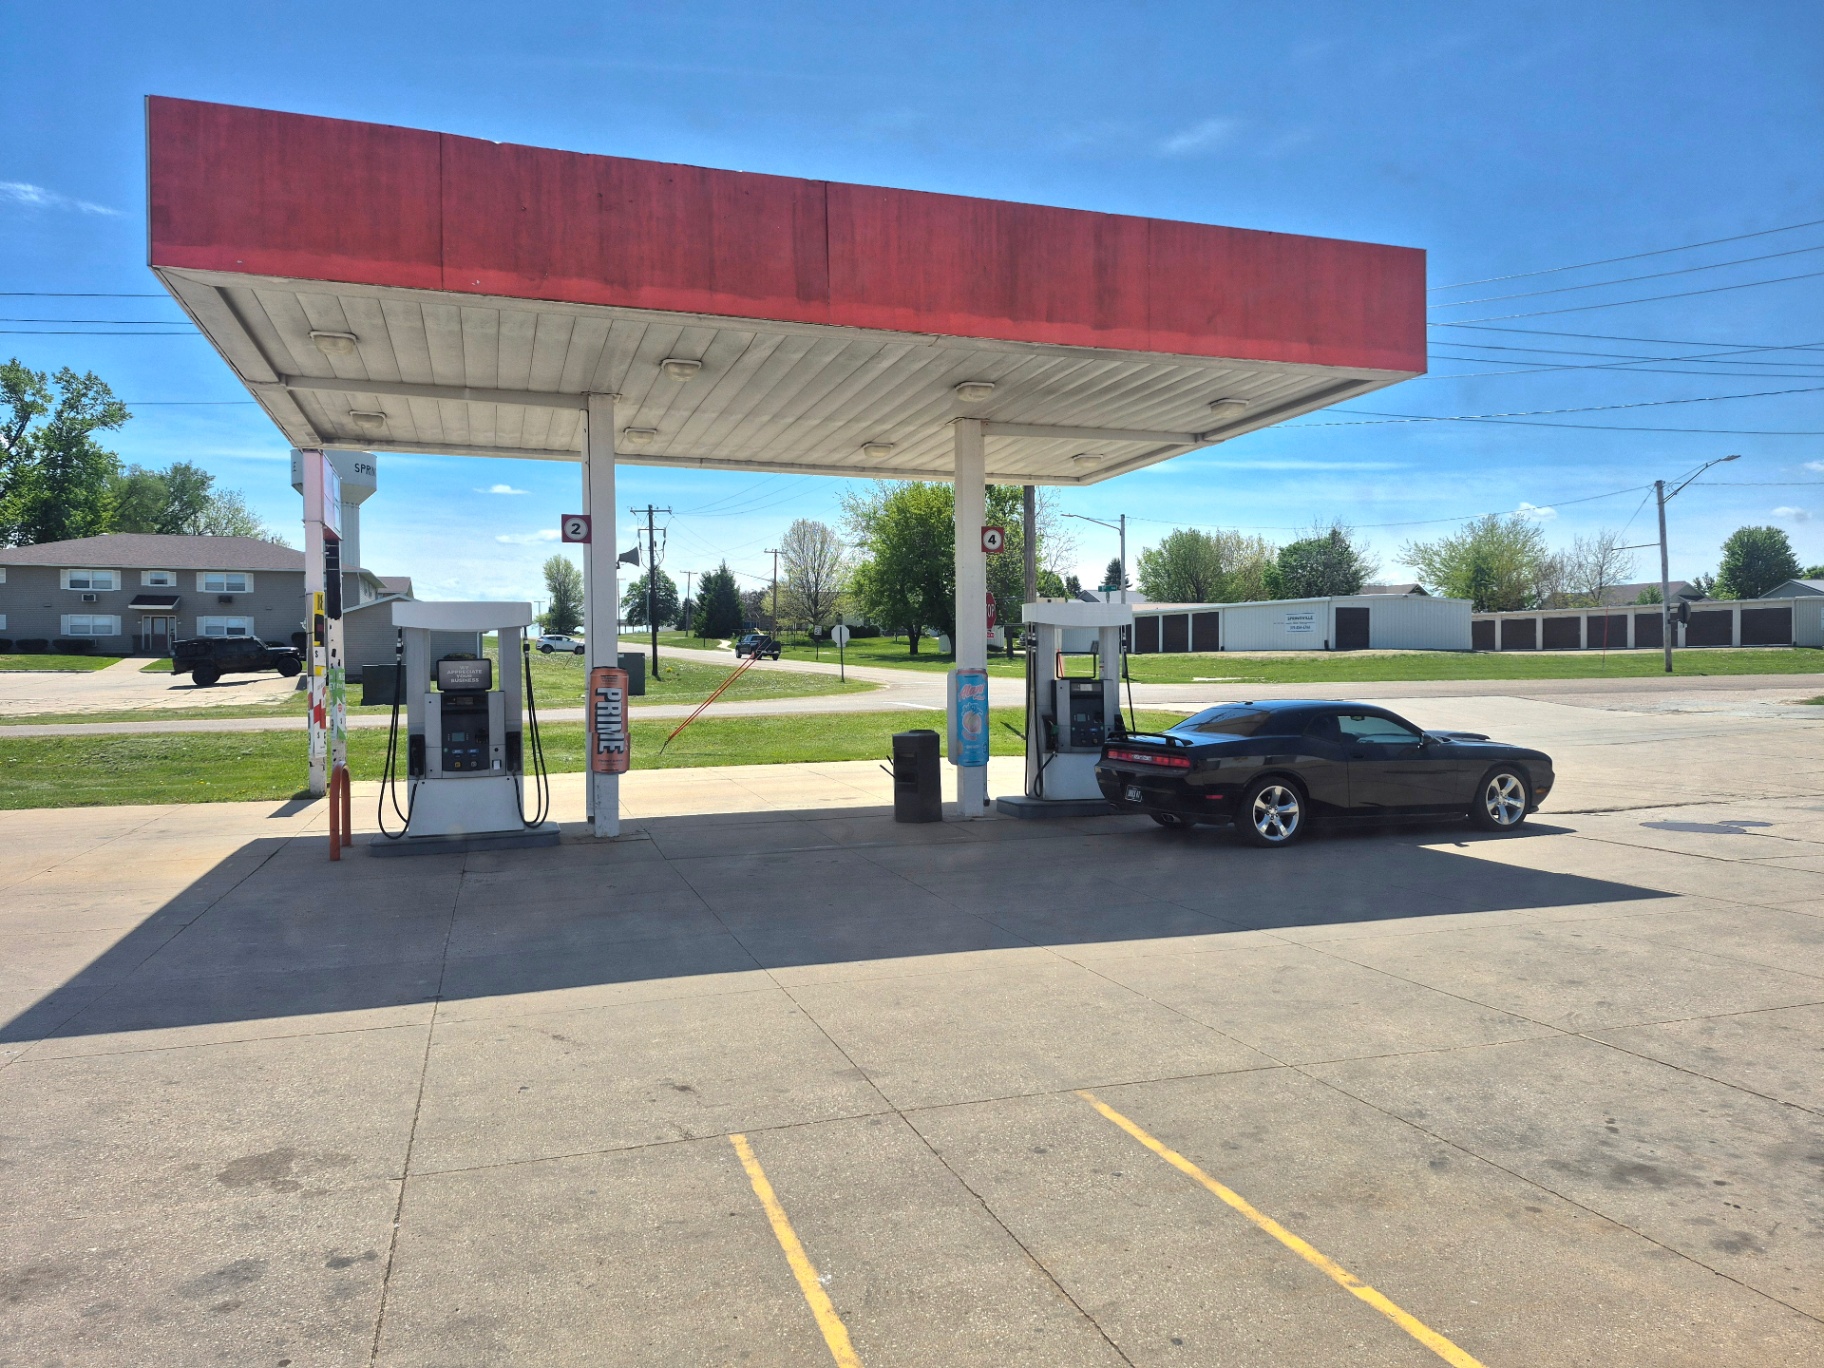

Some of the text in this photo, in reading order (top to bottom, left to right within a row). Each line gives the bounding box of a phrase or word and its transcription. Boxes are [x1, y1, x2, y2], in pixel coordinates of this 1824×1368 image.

[570, 523, 581, 535] 2
[988, 534, 997, 545] 4
[987, 603, 995, 618] OP
[595, 687, 625, 755] PRIME
